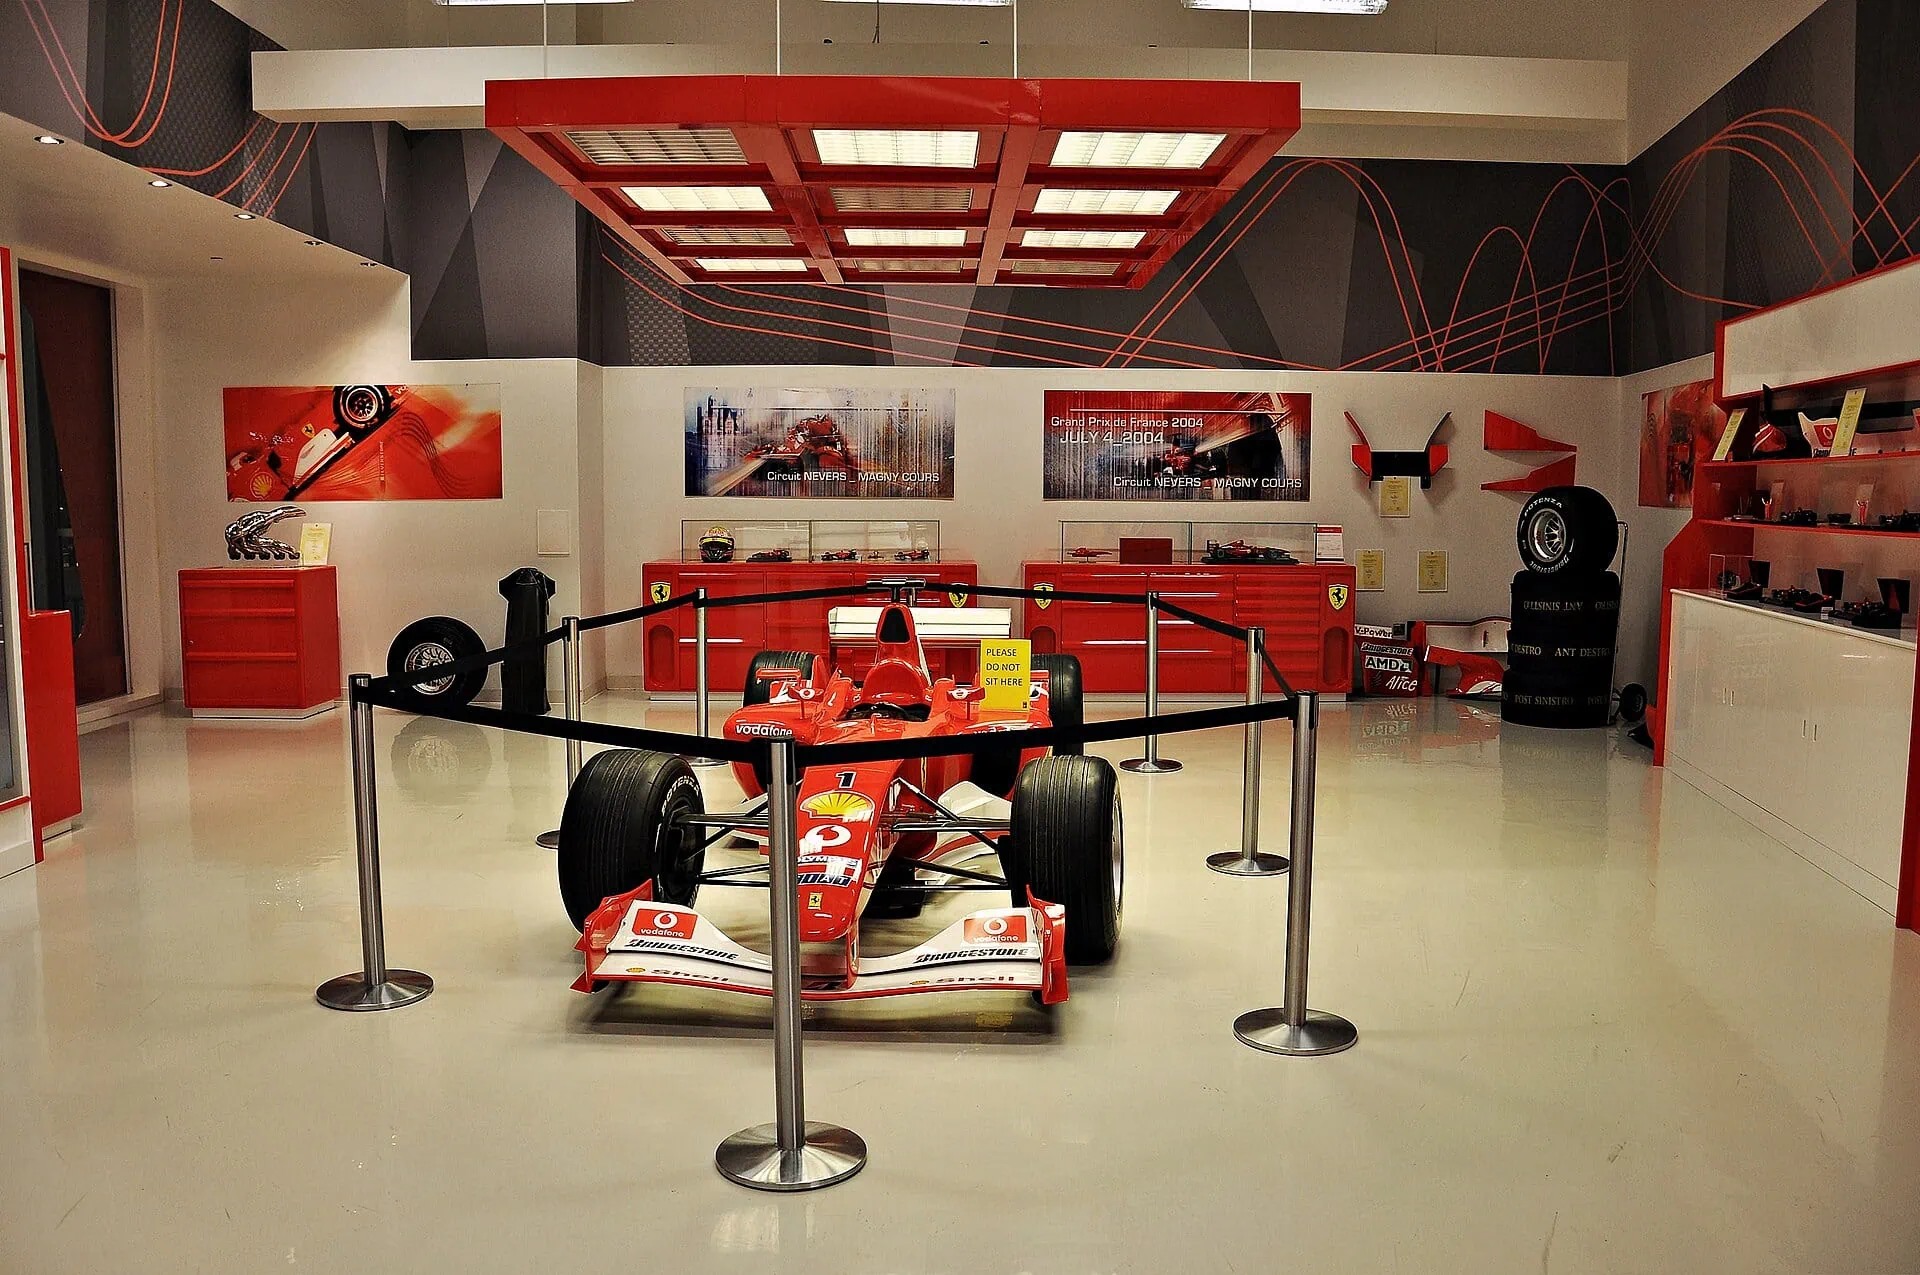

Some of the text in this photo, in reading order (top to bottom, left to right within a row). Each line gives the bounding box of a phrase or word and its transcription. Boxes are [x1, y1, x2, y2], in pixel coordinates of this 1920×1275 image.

[1051, 416, 1204, 428] Grand Prix de France 2004
[1060, 431, 1098, 444] JULY
[767, 471, 801, 481] Circuit
[804, 471, 847, 481] NEVERS
[858, 472, 899, 482] MAGNY
[901, 472, 940, 482] COURS
[1113, 477, 1151, 487] Circuit
[1154, 477, 1201, 487] NEVERS
[1214, 477, 1258, 488] MAGNY
[1261, 478, 1302, 488] COURS
[1355, 626, 1392, 638] V-Power
[986, 648, 1017, 657] PLEASE
[1361, 642, 1414, 656] BRIDGESTONE
[1555, 647, 1577, 657] ANT
[986, 663, 1020, 671] DO NOT
[1365, 656, 1400, 670] AMD
[985, 678, 1023, 686] SIT HERE
[1385, 675, 1418, 692] Alice
[735, 724, 793, 736] vodafone
[836, 771, 857, 789] 1
[798, 873, 852, 886] IAT
[640, 928, 685, 938] vodafone
[973, 933, 1019, 943] vodafone
[624, 938, 739, 961] BRIDGESTONE
[912, 948, 1029, 964] BRIDGESTONE
[651, 968, 729, 982] Shell
